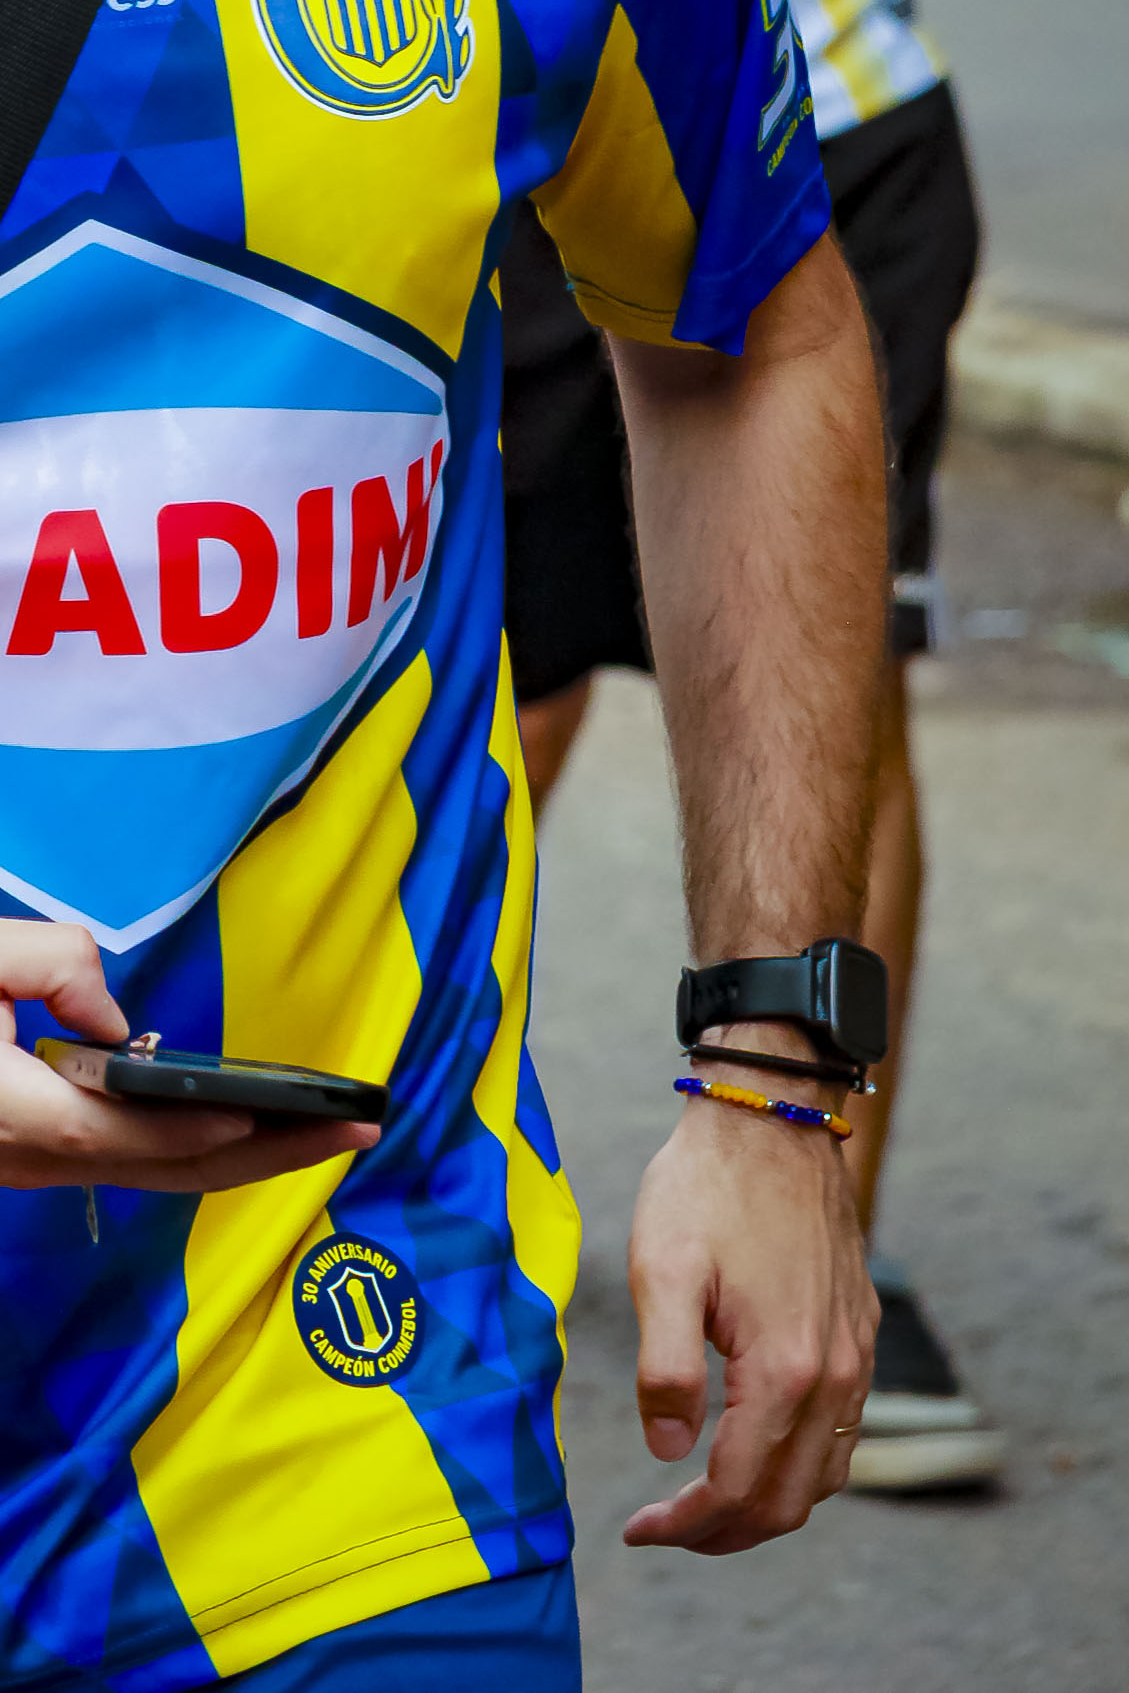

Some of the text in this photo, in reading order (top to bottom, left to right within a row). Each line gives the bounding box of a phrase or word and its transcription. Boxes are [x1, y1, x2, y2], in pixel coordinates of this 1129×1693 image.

[301, 1243, 397, 1304] 30 ANIVERSARIO
[309, 1297, 417, 1378] CAMPEÓN CONMEBOL
